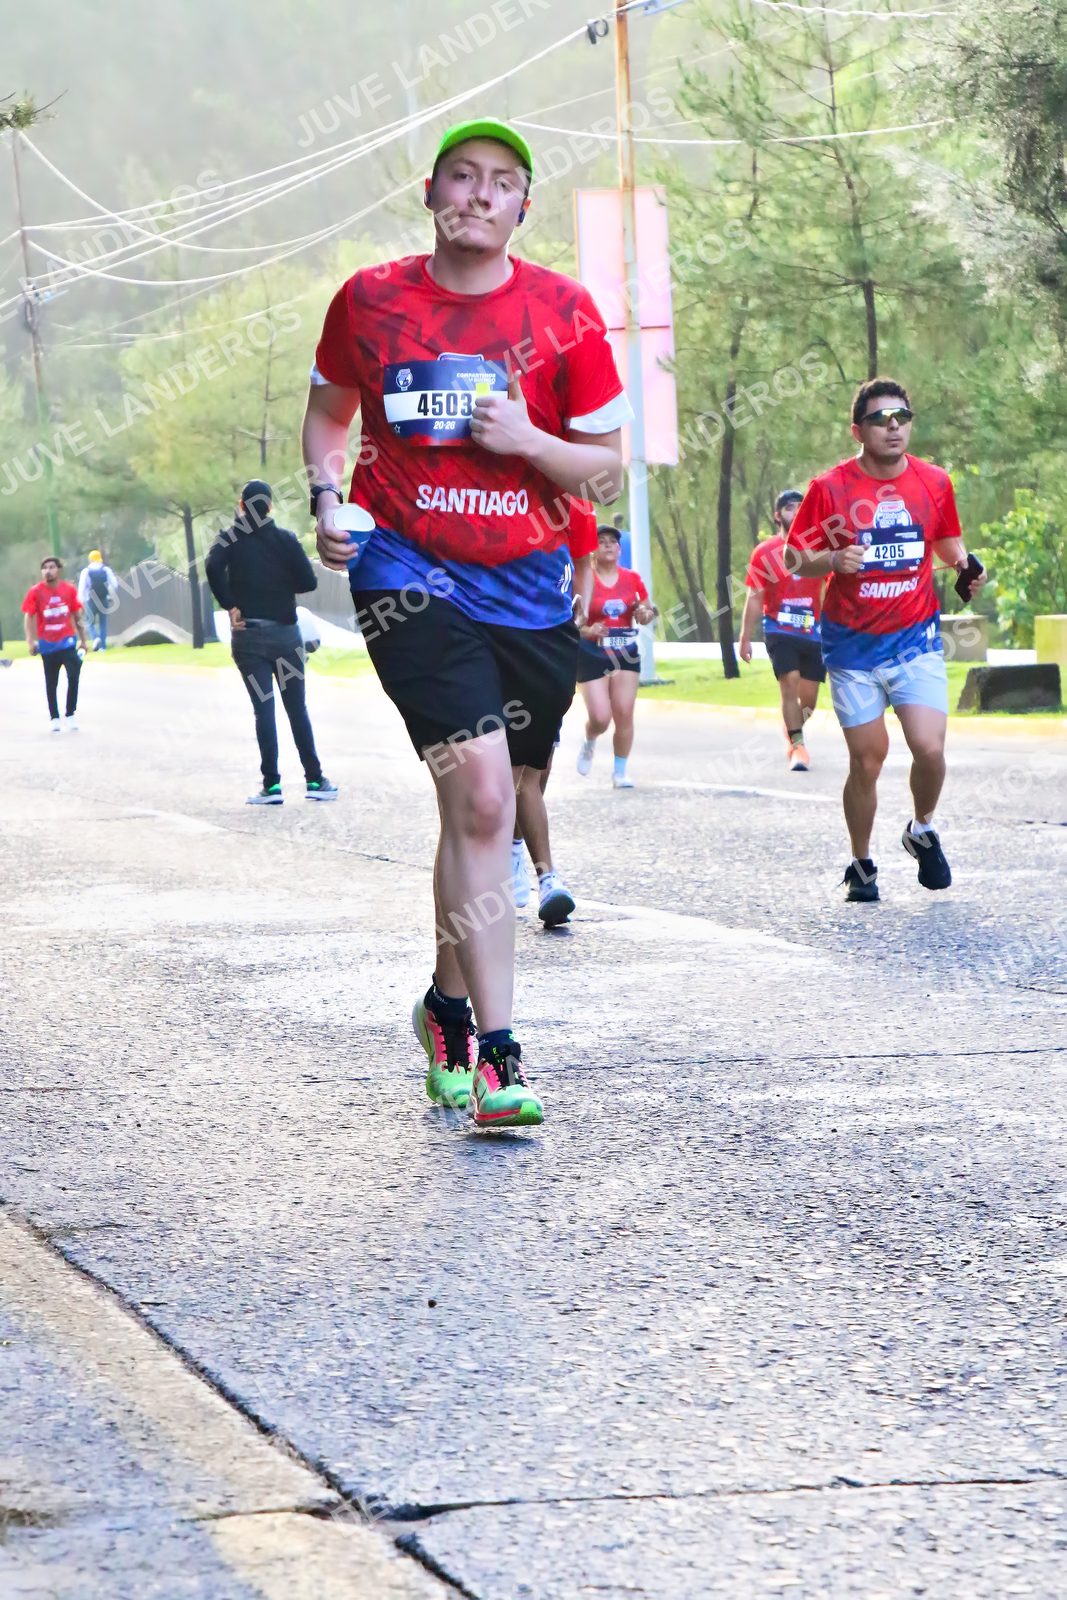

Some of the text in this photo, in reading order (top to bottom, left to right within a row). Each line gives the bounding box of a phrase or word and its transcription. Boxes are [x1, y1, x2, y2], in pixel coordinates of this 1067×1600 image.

[417, 393, 472, 416] 4503
[433, 421, 456, 430] 20-26
[415, 484, 529, 516] SANTIAGO
[874, 544, 905, 559] 4205
